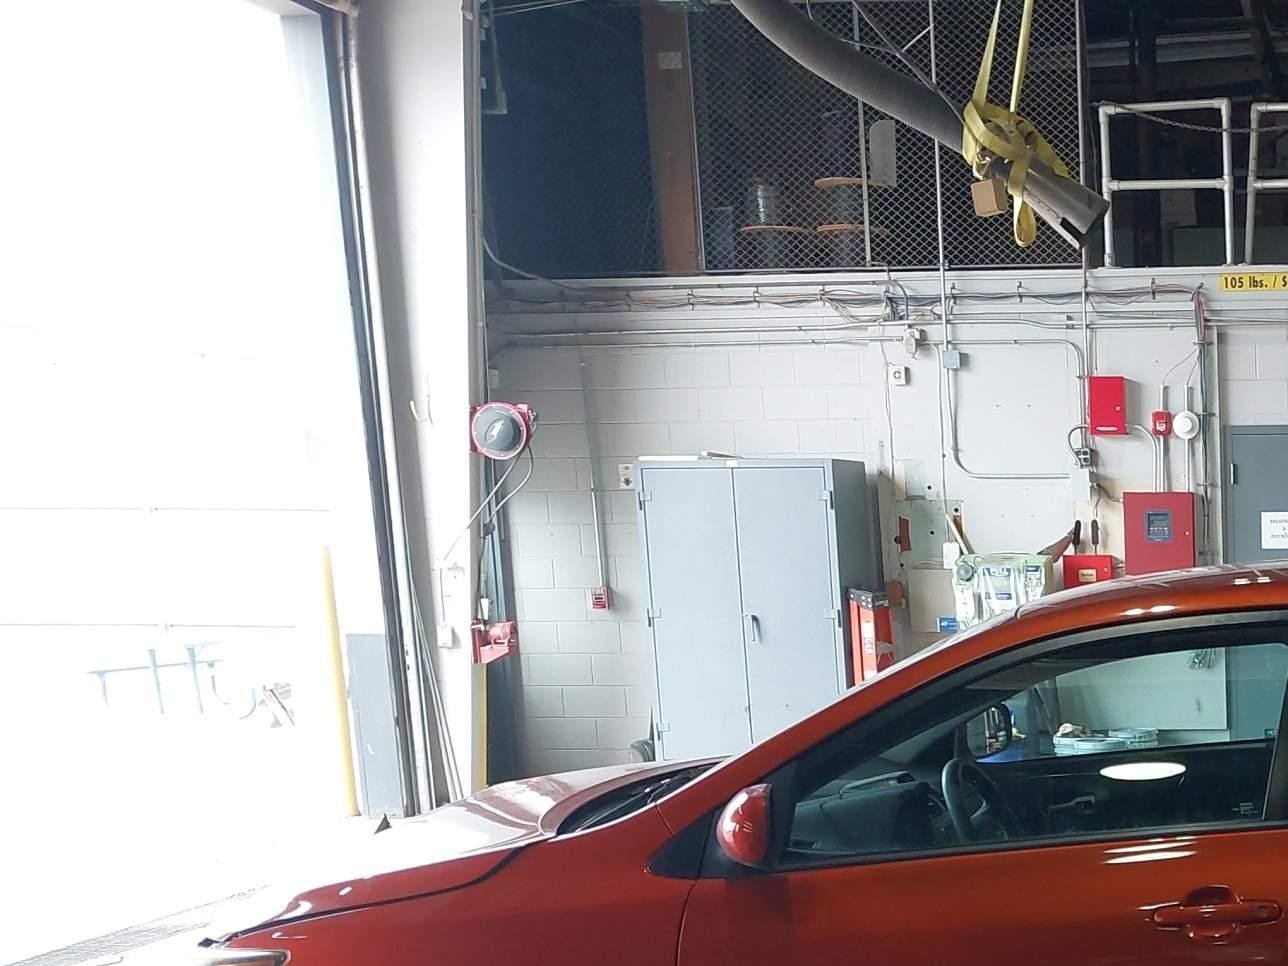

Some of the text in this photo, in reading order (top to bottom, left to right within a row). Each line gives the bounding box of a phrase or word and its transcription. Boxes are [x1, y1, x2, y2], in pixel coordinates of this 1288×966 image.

[1224, 276, 1244, 289] 105
[1248, 275, 1268, 288] lbs.
[1272, 275, 1278, 288] /
